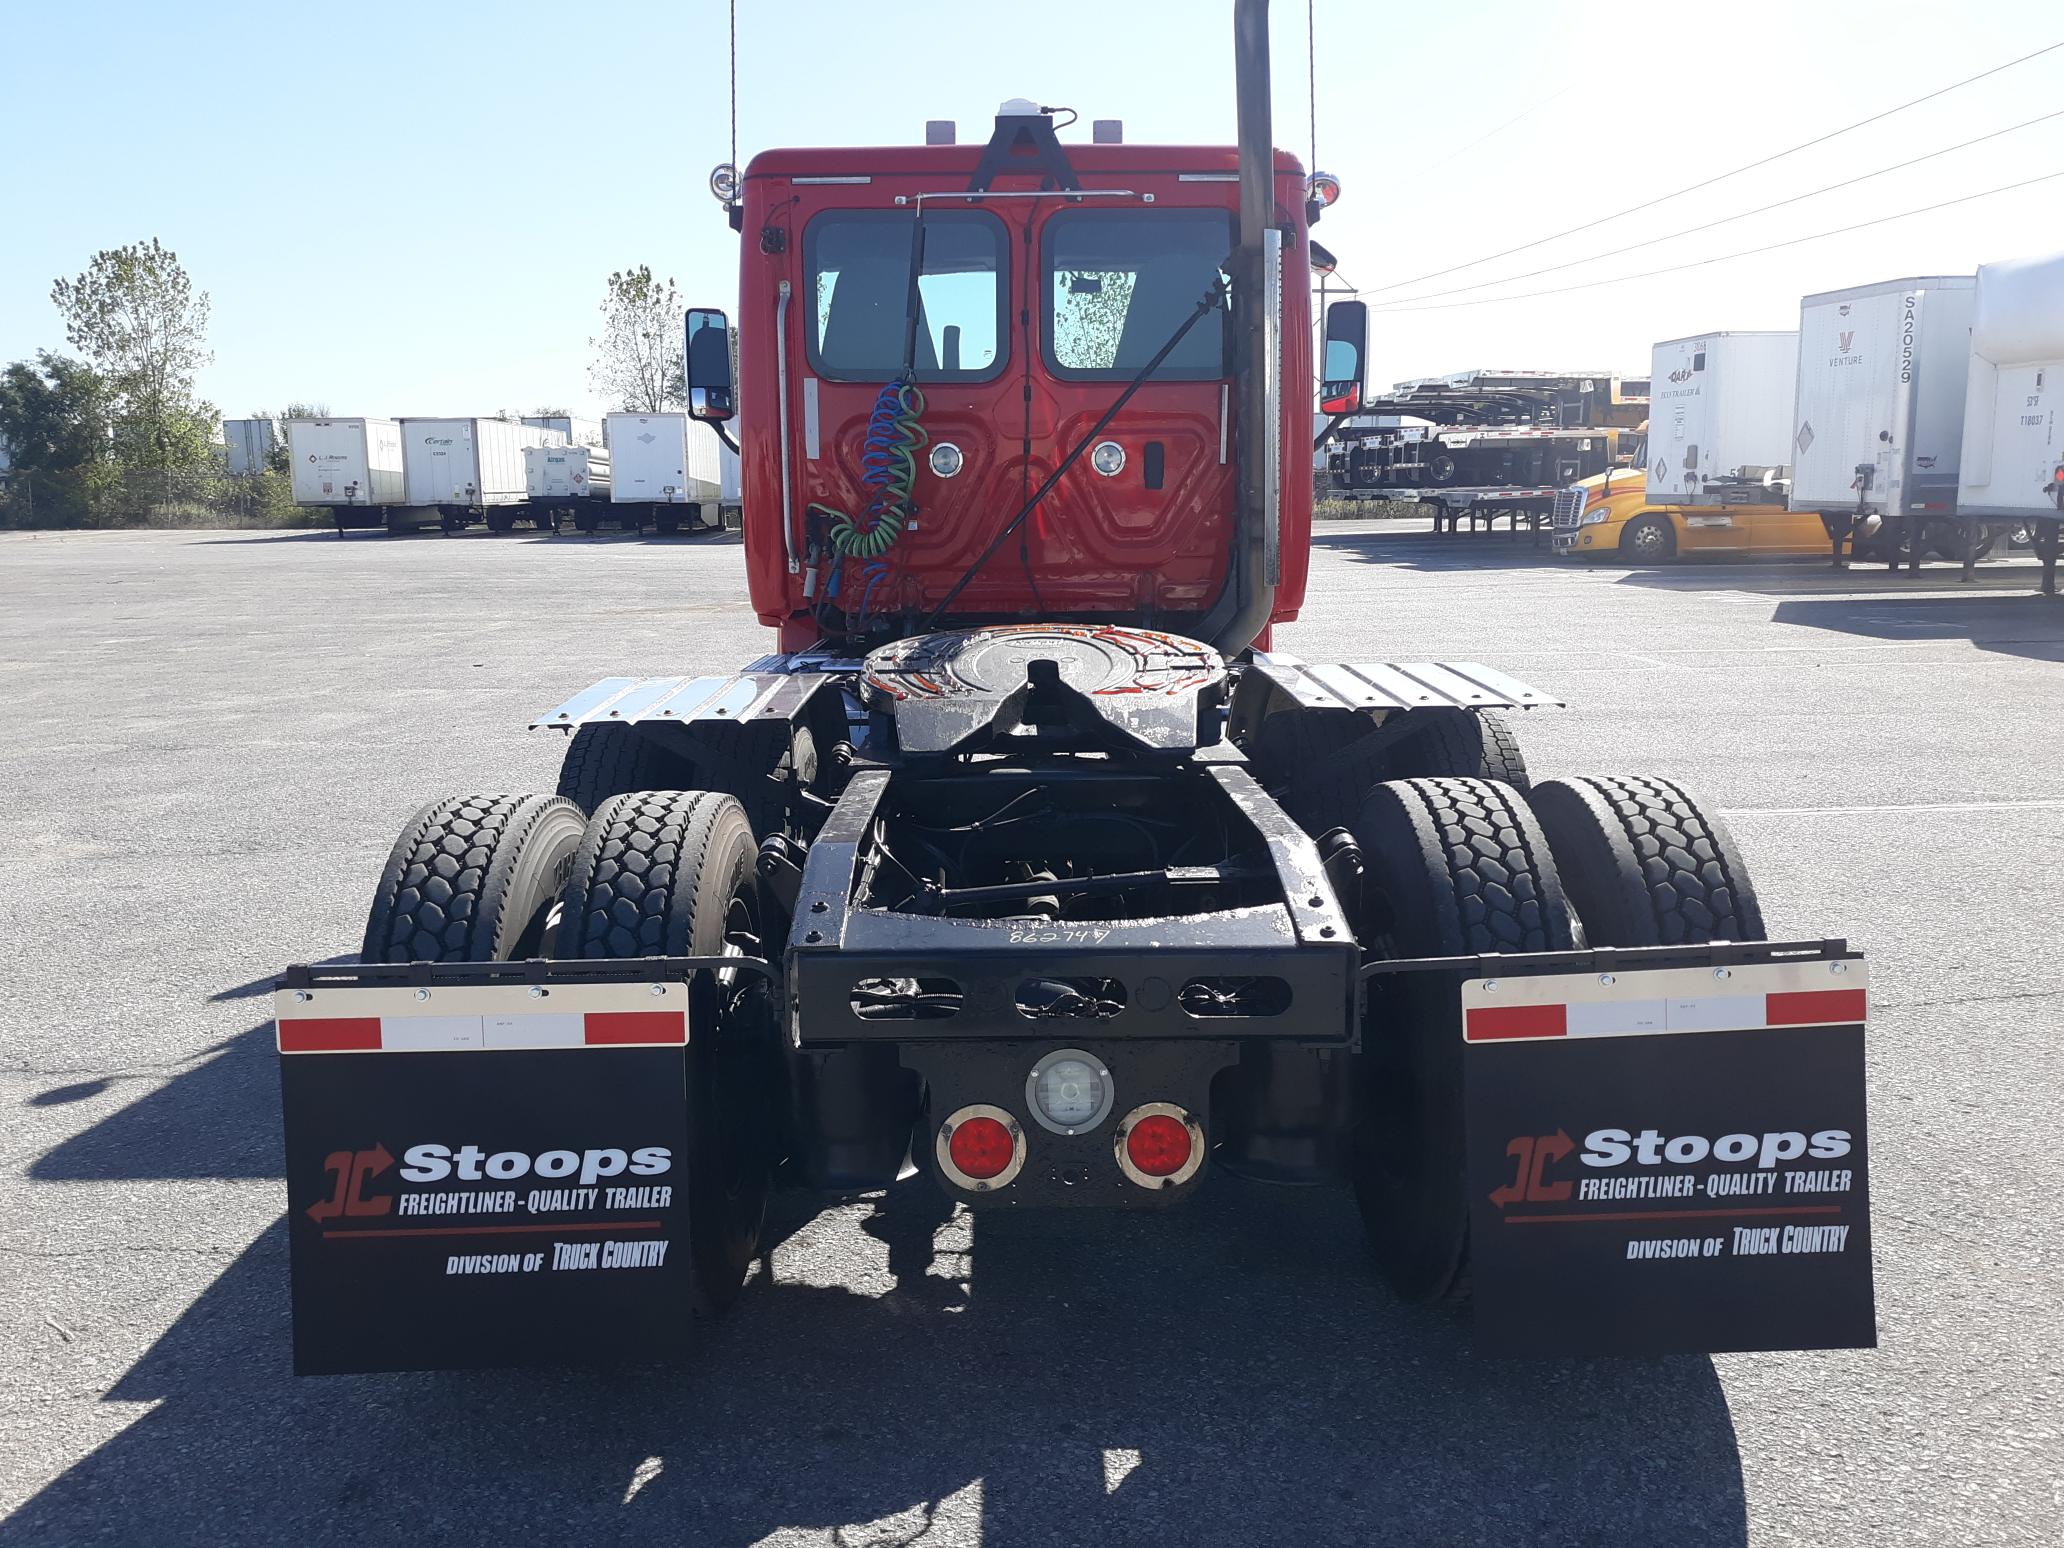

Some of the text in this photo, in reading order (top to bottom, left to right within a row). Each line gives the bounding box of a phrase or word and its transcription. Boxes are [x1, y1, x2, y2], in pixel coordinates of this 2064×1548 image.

[1901, 296, 1915, 383] SA20529
[1829, 355, 1863, 367] VENTURE
[399, 1144, 672, 1184] Stoops
[1580, 1129, 1851, 1168] Stoops
[605, 1186, 672, 1210] TRAILER
[1785, 1169, 1852, 1194] TRAILER
[446, 1240, 669, 1275] DIVISION OF TRUCK COUNTRY
[1626, 1225, 1850, 1260] DIVISION OF TRUCK COUNTRY
